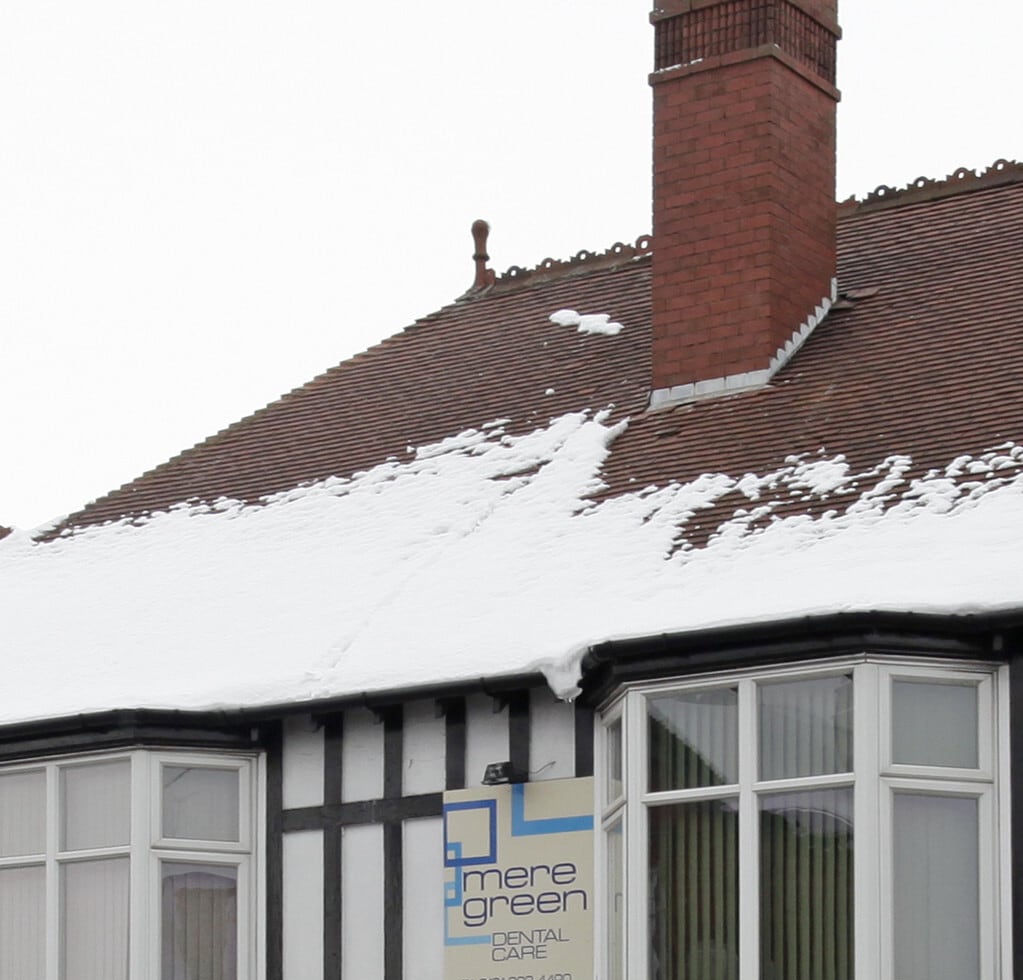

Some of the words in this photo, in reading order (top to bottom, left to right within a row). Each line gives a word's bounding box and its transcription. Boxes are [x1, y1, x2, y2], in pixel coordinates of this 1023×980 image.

[463, 863, 576, 892] mere
[463, 889, 587, 927] green
[492, 928, 571, 947] DENTAL
[491, 945, 548, 962] CARE
